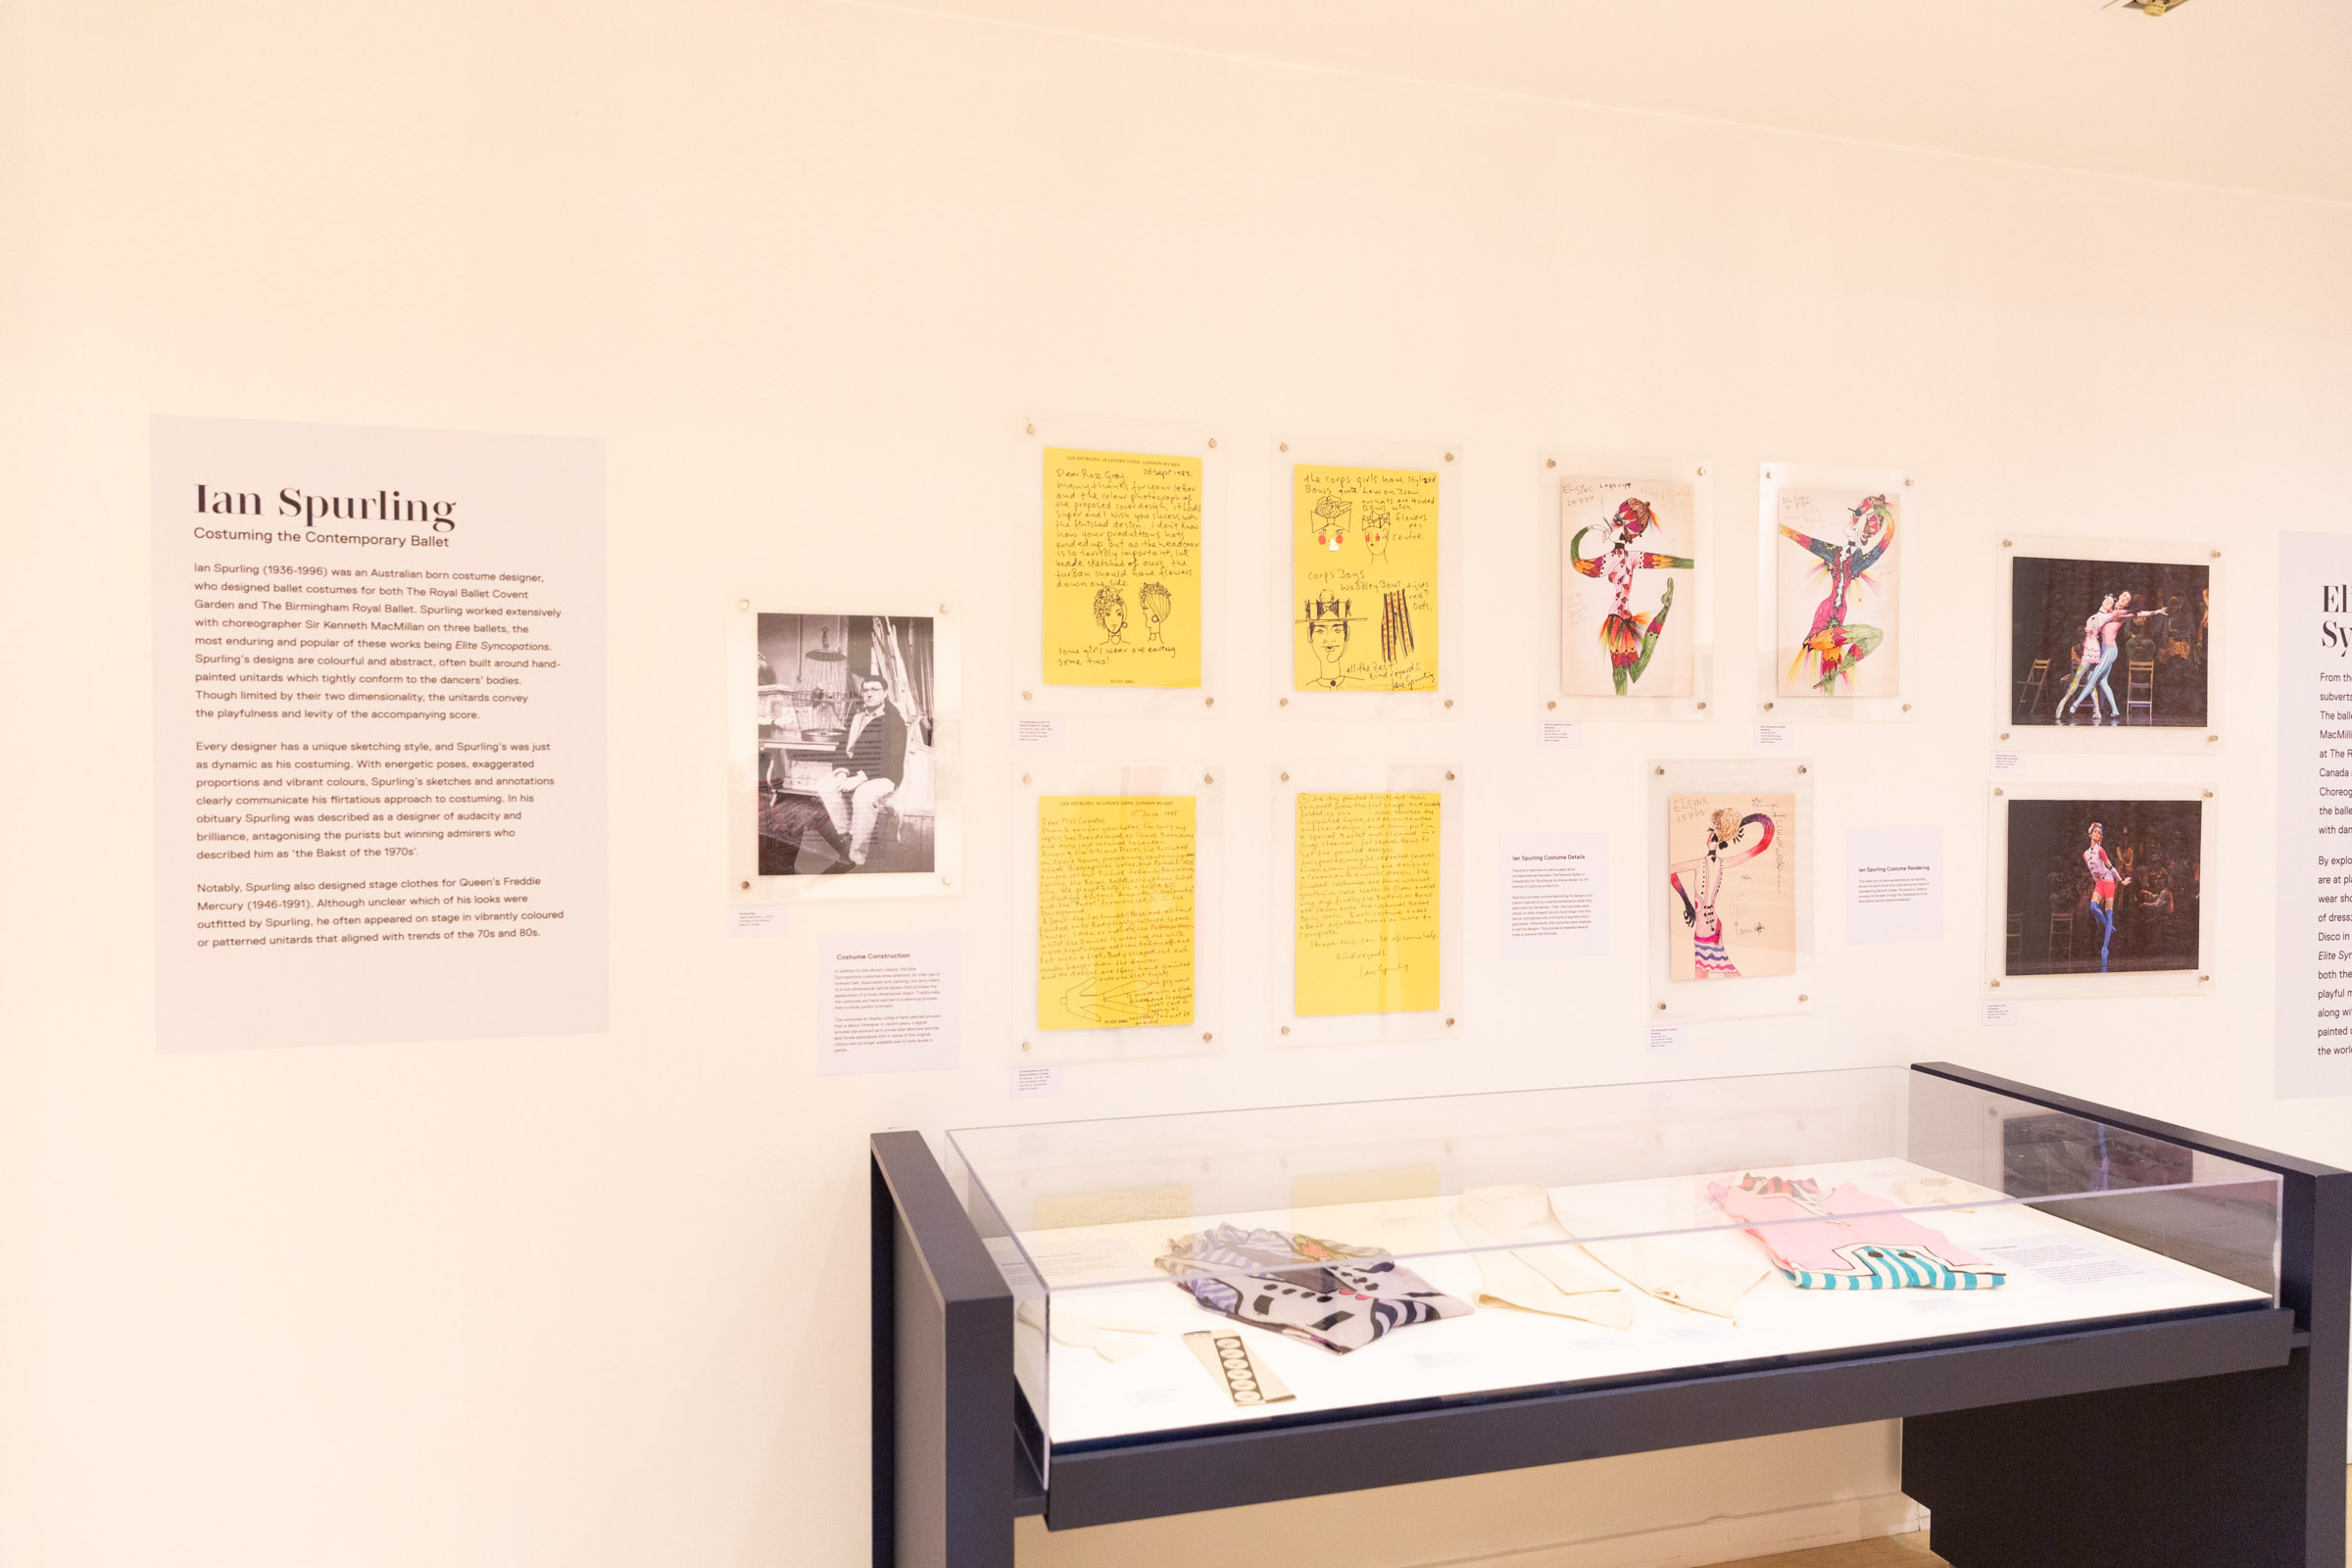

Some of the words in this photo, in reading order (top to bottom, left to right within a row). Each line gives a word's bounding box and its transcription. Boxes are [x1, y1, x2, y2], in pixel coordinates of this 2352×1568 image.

[195, 483, 265, 515] Ian
[278, 487, 457, 533] Spurling
[194, 526, 272, 544] Costuming
[277, 529, 301, 542] the
[305, 530, 406, 548] Contemporary
[411, 534, 449, 548] Ballet
[194, 562, 211, 572] Ian
[214, 563, 259, 576] Spurling
[263, 564, 328, 578] (1936-1996)
[370, 568, 423, 579] Australian
[426, 570, 449, 579] born
[452, 572, 496, 581] costume
[499, 572, 544, 584] designer,
[194, 581, 218, 591] who
[221, 581, 270, 594] designed
[273, 583, 303, 593] ballet
[306, 585, 358, 595] costumes
[361, 585, 376, 595] for
[379, 586, 403, 596] both
[406, 586, 426, 596] The
[429, 587, 458, 599] Royal
[461, 588, 490, 598] Ballet
[492, 589, 528, 599] Covent
[2321, 584, 2352, 612] El
[194, 599, 235, 609] Garden
[238, 600, 258, 610] and
[261, 600, 282, 611] The
[285, 601, 349, 614] Birmingham
[352, 603, 381, 614] Royal
[385, 603, 417, 614] Ballet.
[420, 604, 463, 617] Spurling
[465, 606, 503, 616] worked
[506, 608, 561, 619] extensively
[195, 617, 219, 627] with
[222, 618, 302, 630] choreographer
[305, 619, 320, 629] Sir
[324, 620, 368, 630] Kenneth
[371, 621, 425, 631] MacMillan
[443, 622, 471, 633] three
[473, 623, 509, 634] ballets,
[512, 624, 529, 634] the
[2320, 671, 2341, 682] From
[2343, 672, 2352, 682] th
[2320, 710, 2335, 720] The
[2337, 710, 2352, 720] ball
[2319, 749, 2328, 758] at
[2329, 748, 2345, 758] The
[211, 760, 258, 771] dynamic
[276, 760, 292, 769] his
[294, 760, 353, 771] costuming.
[357, 759, 382, 769] With
[385, 760, 433, 771] energetic
[437, 761, 469, 770] poses,
[472, 759, 534, 770] exaggerated
[2319, 767, 2349, 778] Canada
[2319, 805, 2333, 815] the
[2318, 824, 2336, 835] with
[2318, 855, 2329, 867] By
[197, 883, 242, 894] Notably,
[245, 882, 291, 894] Spurling
[294, 881, 315, 891] also
[318, 880, 366, 892] designed
[369, 881, 398, 891] stage
[401, 879, 439, 889] clothes
[441, 878, 456, 887] for
[459, 877, 501, 887] Queen's
[504, 876, 541, 886] Freddie
[2318, 876, 2331, 885] are
[2333, 875, 2341, 884] at
[2344, 874, 2352, 886] pl
[197, 901, 244, 912] Mercury
[247, 899, 314, 911] (1946-1991).
[317, 897, 365, 909] Although
[368, 897, 407, 907] unclear
[409, 896, 440, 905] which
[443, 895, 454, 905] of
[457, 895, 472, 904] his
[474, 894, 501, 904] looks
[2318, 895, 2338, 903] wear
[2318, 912, 2327, 923] of
[212, 936, 266, 949] patterned
[269, 935, 313, 945] unitards
[316, 934, 338, 943] that
[341, 932, 378, 944] aligned
[382, 931, 404, 941] with
[407, 931, 441, 940] trends
[443, 930, 455, 939] of
[457, 930, 474, 939] the
[477, 929, 495, 938] 70s
[498, 928, 516, 938] and
[519, 927, 540, 937] 80s.
[2318, 931, 2341, 942] Disco
[2343, 931, 2350, 941] in
[2318, 950, 2337, 961] Elite
[2318, 969, 2338, 980] both
[2339, 969, 2352, 979] the
[2318, 988, 2345, 1001] playful
[2318, 1008, 2340, 1019] along
[2318, 1025, 2348, 1039] painted
[2318, 1044, 2331, 1056] the
